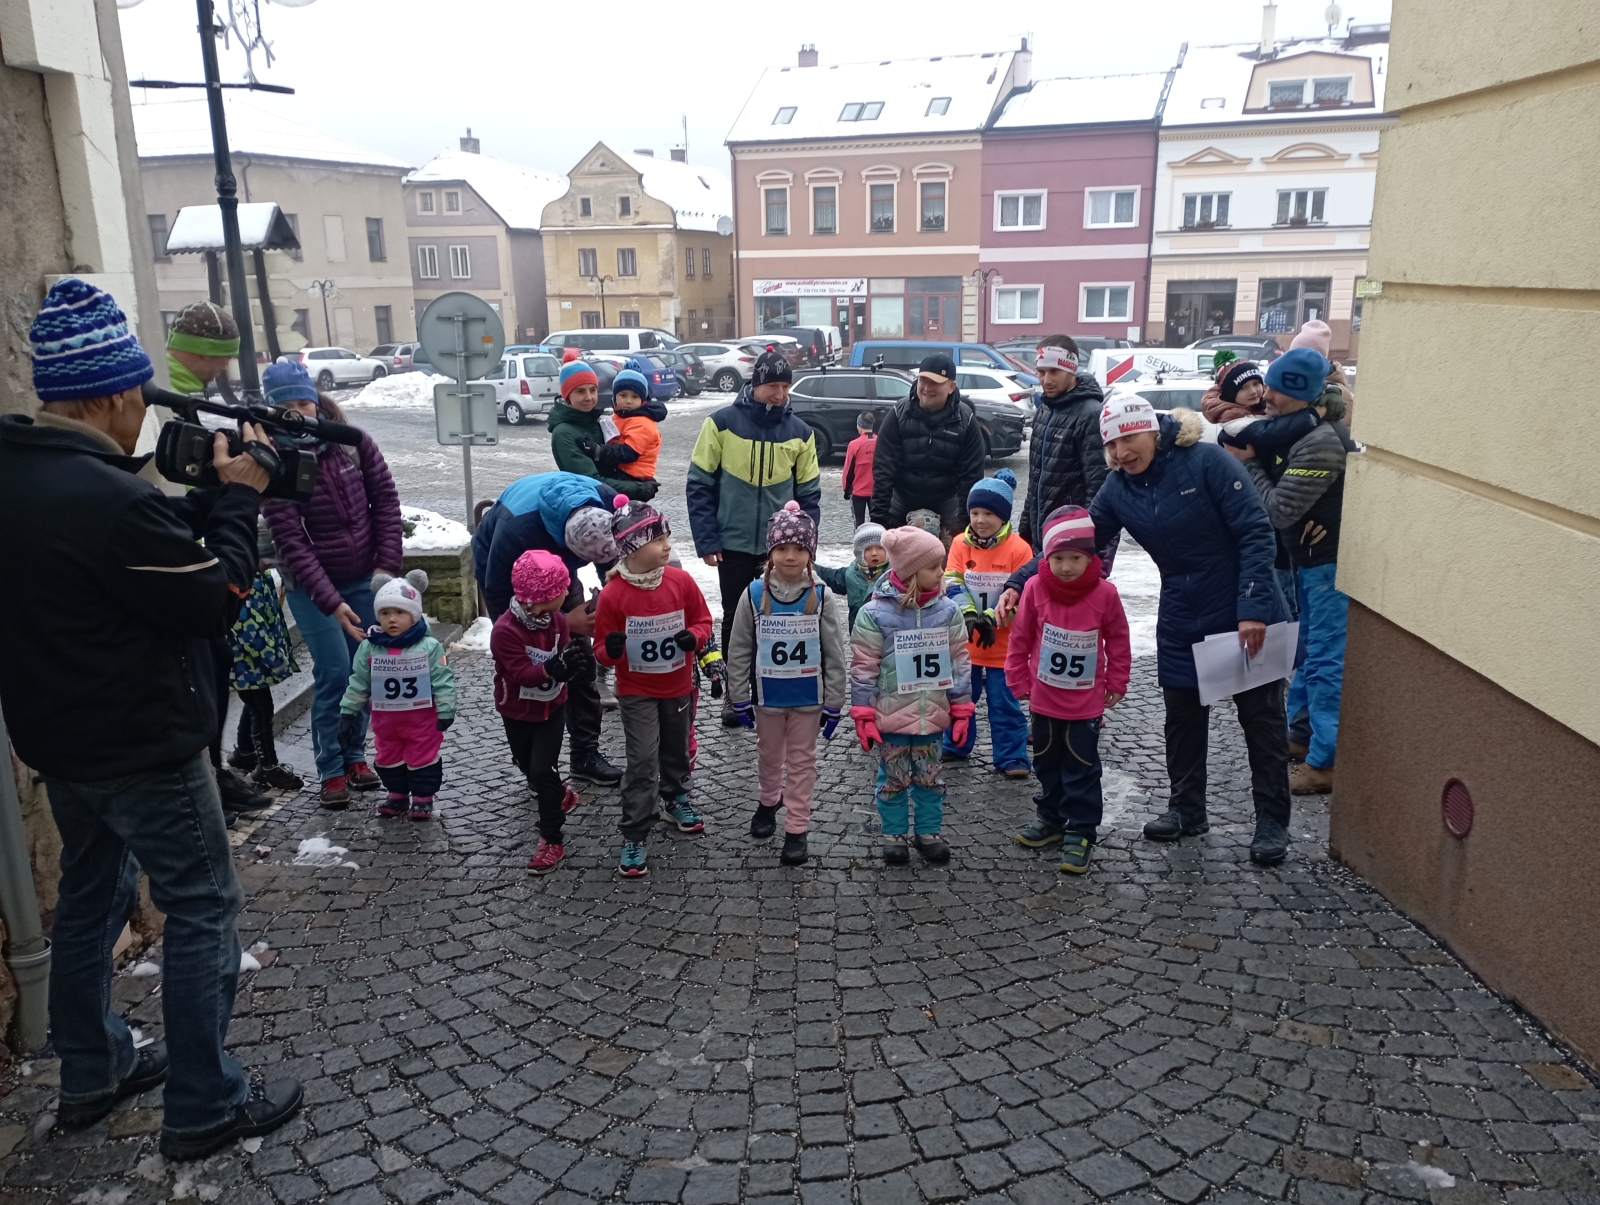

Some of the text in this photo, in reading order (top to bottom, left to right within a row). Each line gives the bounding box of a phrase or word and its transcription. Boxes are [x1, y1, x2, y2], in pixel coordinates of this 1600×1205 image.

[1145, 355, 1185, 377] SERVIS
[1233, 369, 1260, 386] MINECR
[1124, 404, 1141, 414] LES
[1118, 420, 1153, 432] MARATON
[628, 618, 654, 628] ZIMNÍ
[667, 621, 683, 631] LIGA
[761, 619, 787, 627] ZIMNÍ
[761, 627, 799, 635] BĚŽECKÁ
[1045, 627, 1070, 641] ZIMNÍ
[896, 632, 923, 643] ZIMNÍ
[641, 637, 676, 663] 86
[896, 641, 935, 650] BĚŽECKÁ
[936, 639, 948, 647] LIGA
[1081, 642, 1097, 650] LIGA
[771, 641, 808, 666] 64
[912, 653, 941, 679] 15
[1049, 652, 1086, 678] 95
[384, 677, 418, 700] 93
